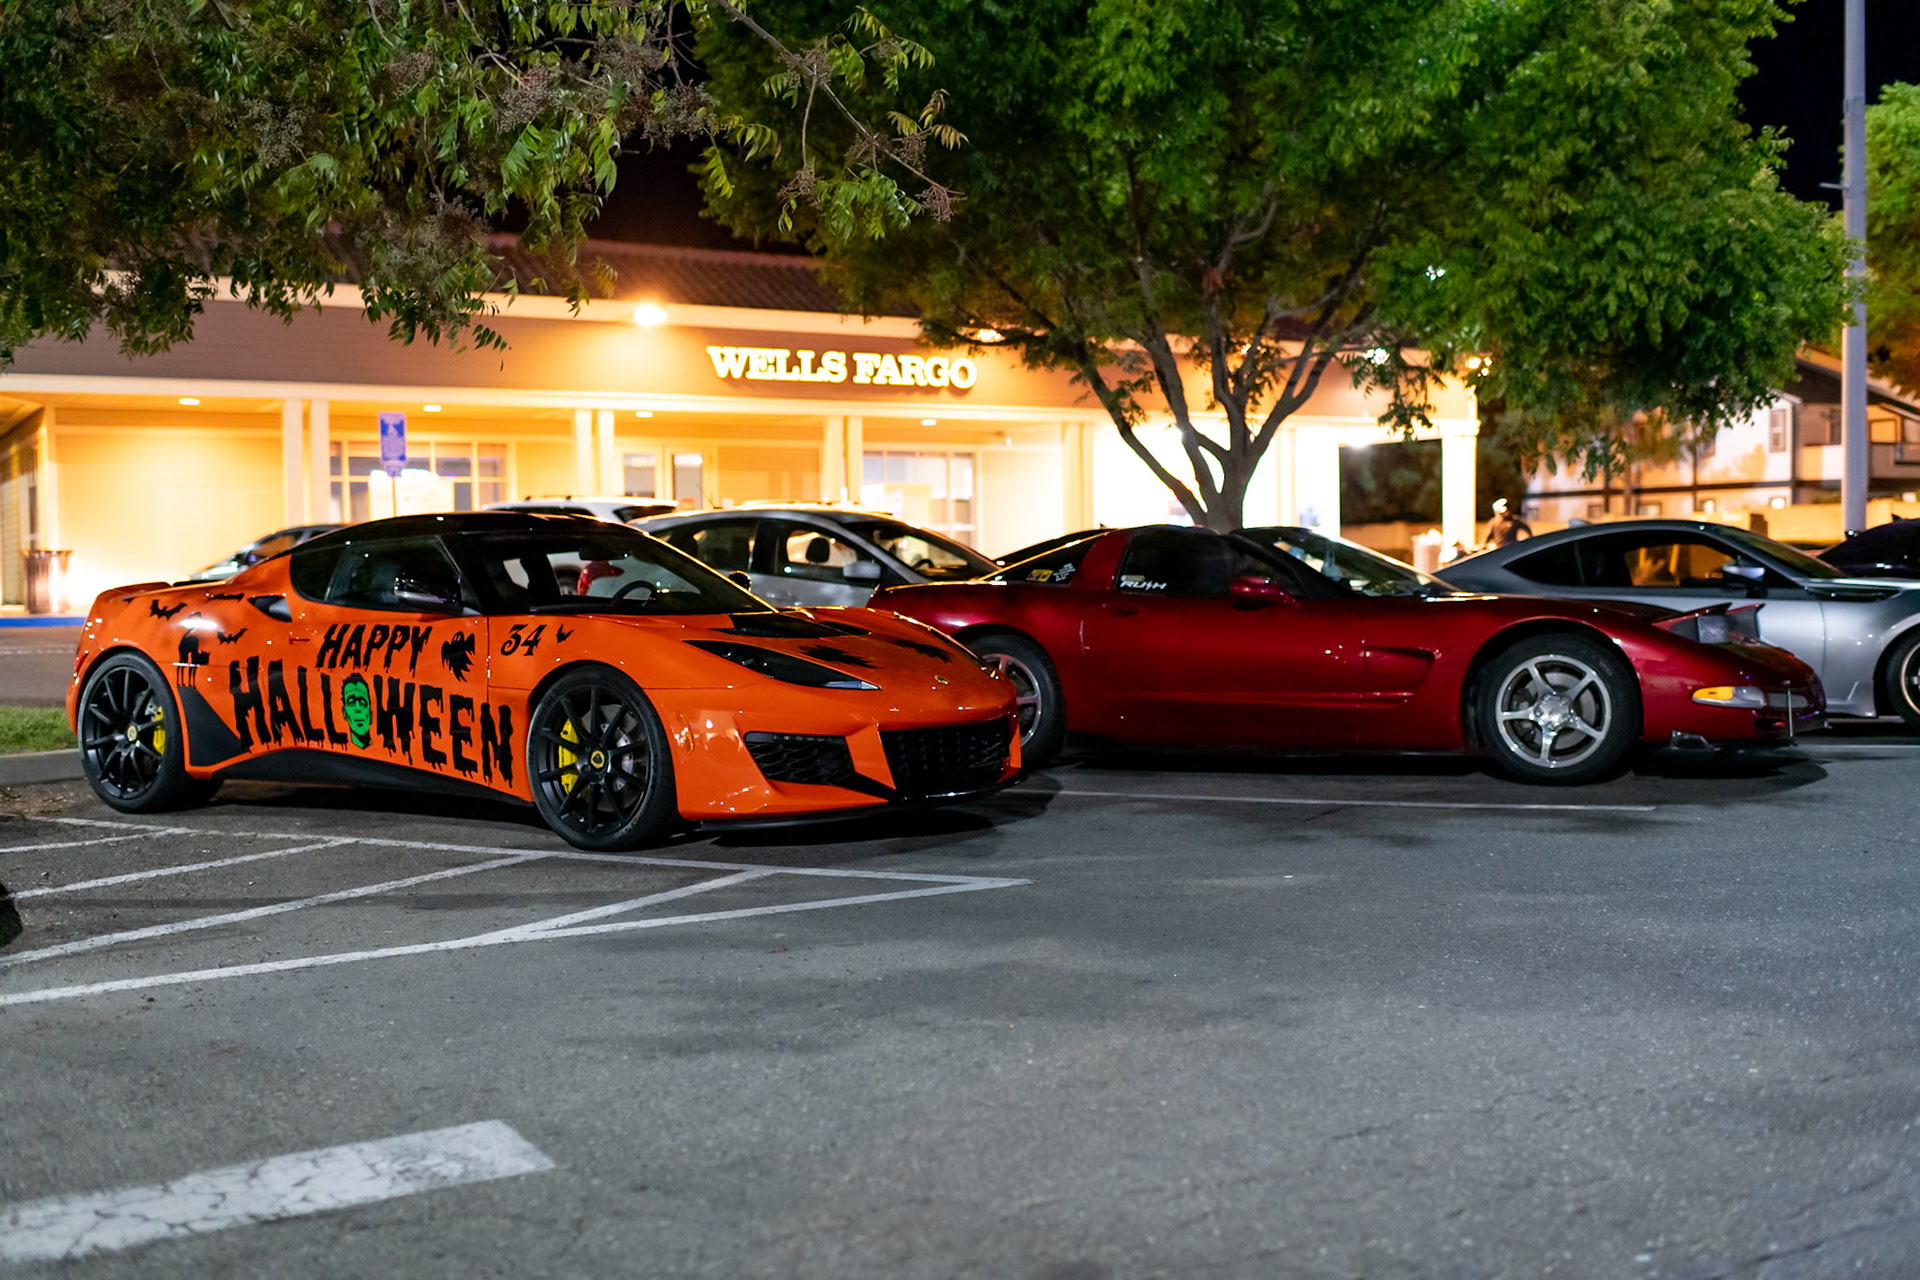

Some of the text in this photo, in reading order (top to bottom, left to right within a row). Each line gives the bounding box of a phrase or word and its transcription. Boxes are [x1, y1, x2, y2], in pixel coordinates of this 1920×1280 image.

[706, 346, 978, 389] WELLS FARGO
[315, 624, 433, 678] HAPPY
[500, 624, 547, 656] 34
